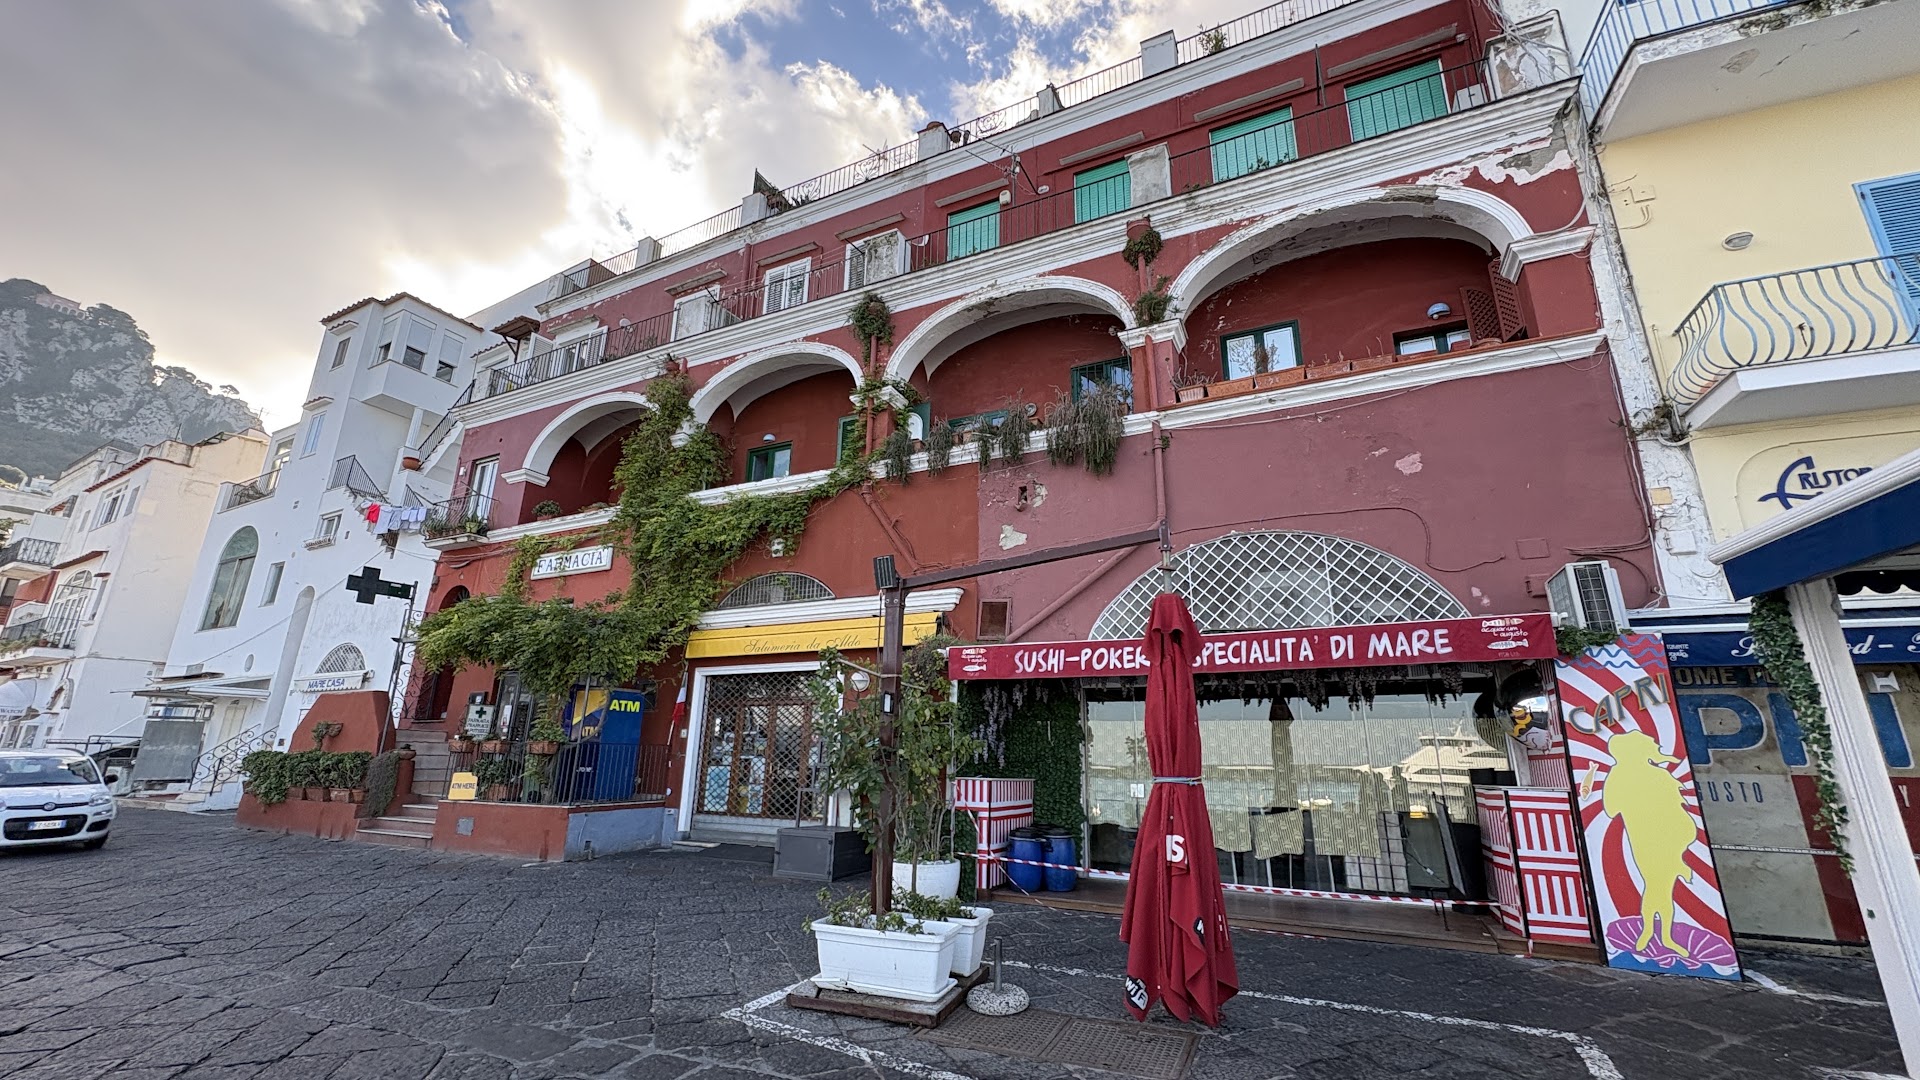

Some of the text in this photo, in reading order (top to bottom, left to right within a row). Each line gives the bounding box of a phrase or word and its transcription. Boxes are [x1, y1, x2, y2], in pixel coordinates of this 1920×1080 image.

[537, 548, 604, 573] FARMACIA
[1500, 629, 1529, 641] augusto
[743, 634, 861, 654] Salumeria da Aldo
[1330, 634, 1354, 660] DI
[1367, 628, 1453, 658] MARE
[327, 678, 345, 688] CASA
[609, 700, 641, 713] ATM
[1568, 672, 1671, 735] CAPRI
[462, 782, 476, 790] HERE
